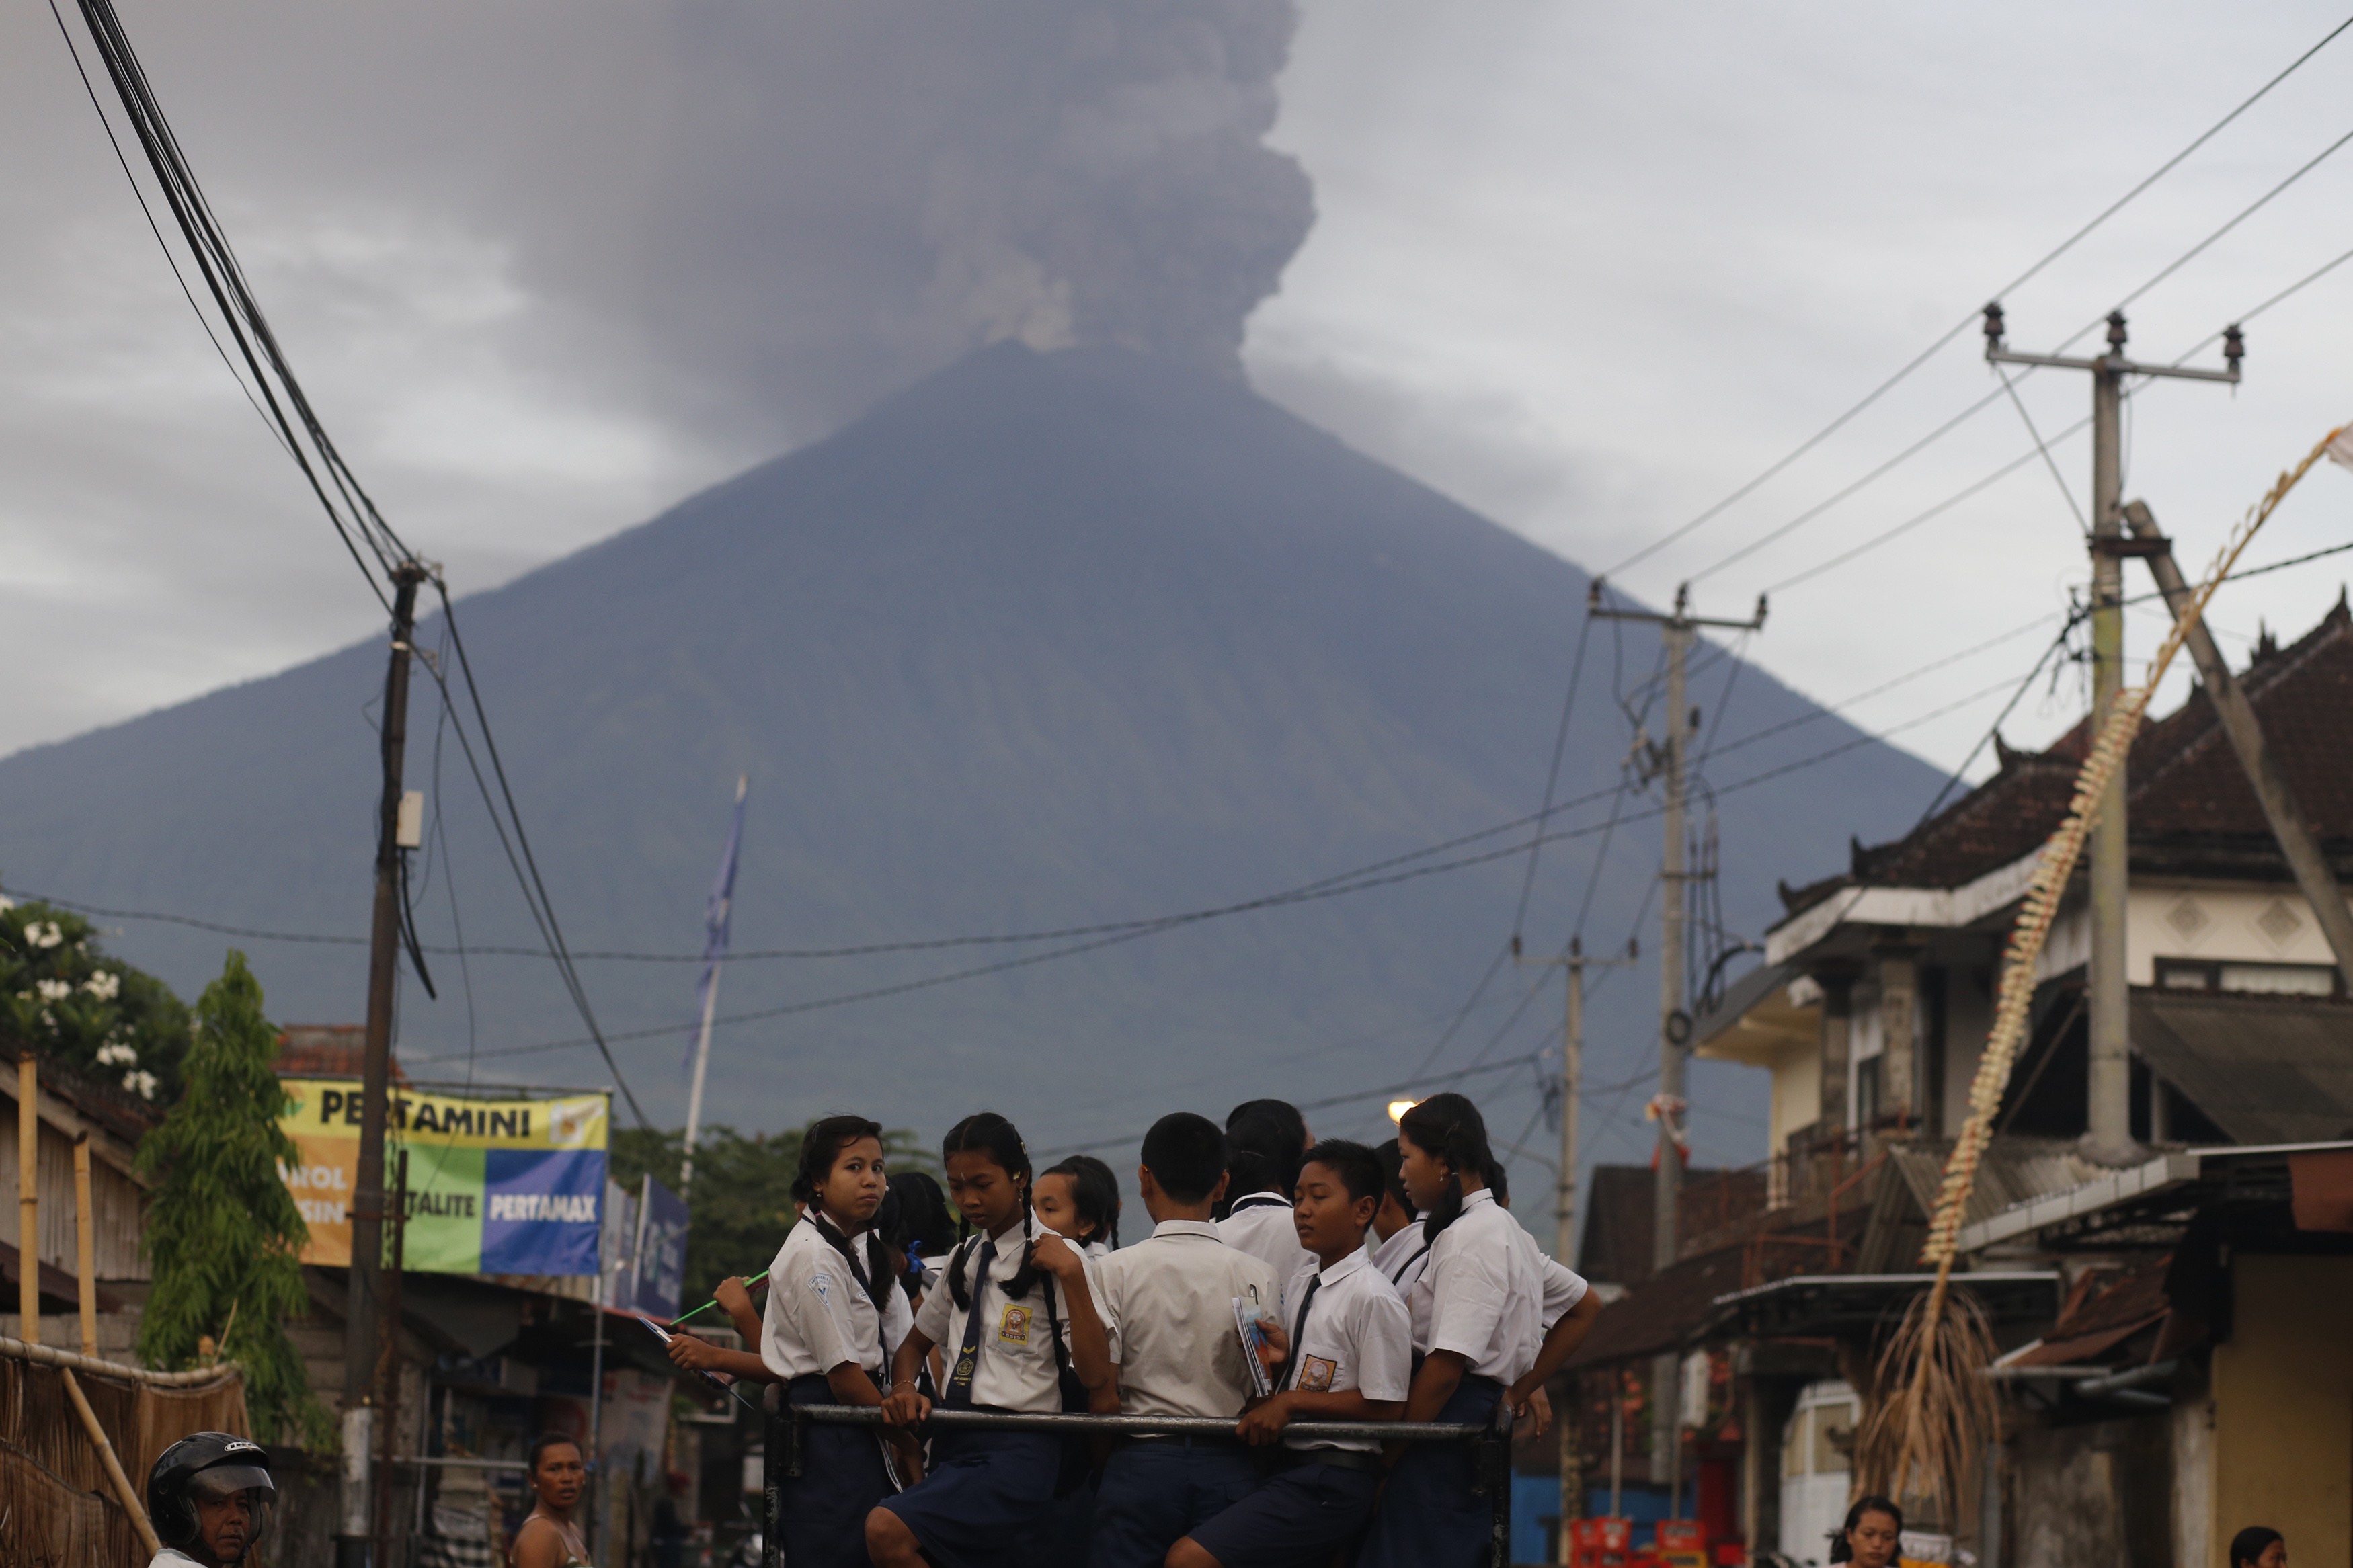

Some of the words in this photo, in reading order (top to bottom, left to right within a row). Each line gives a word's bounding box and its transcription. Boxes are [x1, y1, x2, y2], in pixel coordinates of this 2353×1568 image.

[320, 1090, 529, 1137] PETAMINI
[296, 1200, 346, 1225] SIN
[395, 1191, 475, 1218] TALITE
[490, 1194, 596, 1222] PERTAMAX
